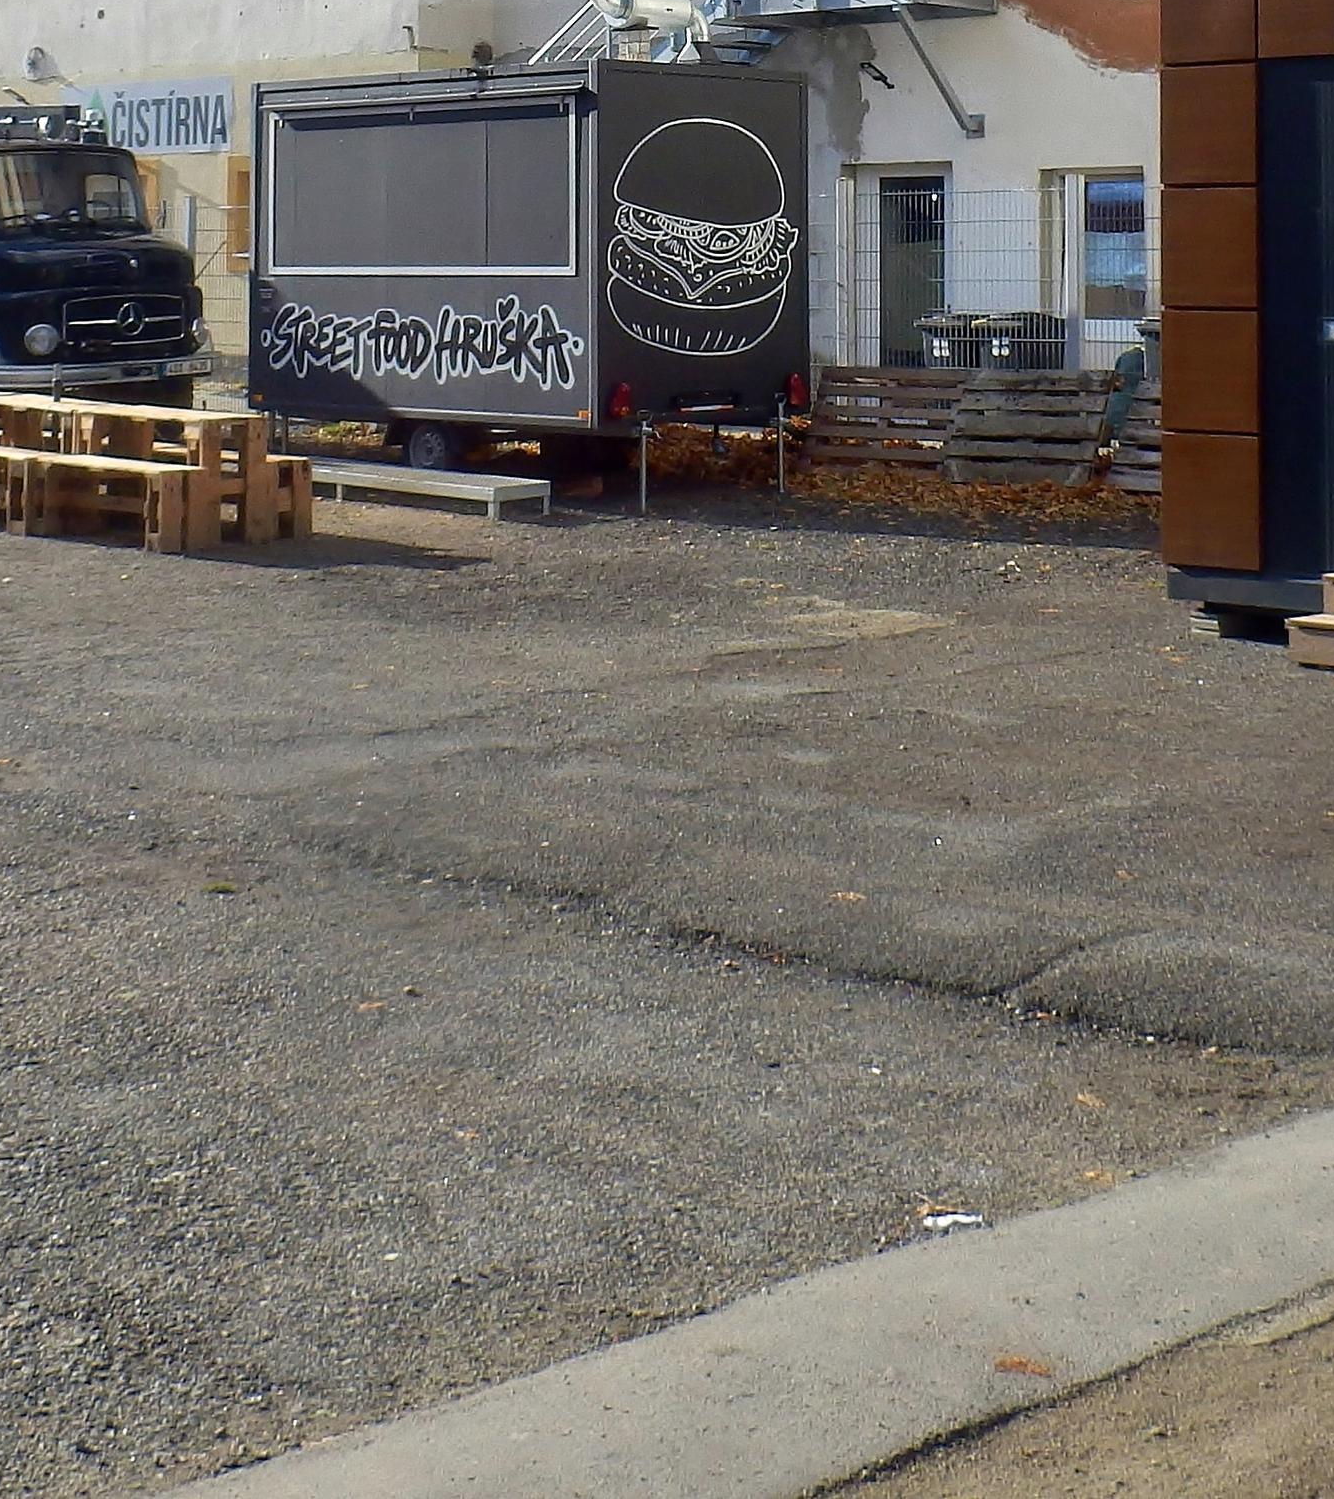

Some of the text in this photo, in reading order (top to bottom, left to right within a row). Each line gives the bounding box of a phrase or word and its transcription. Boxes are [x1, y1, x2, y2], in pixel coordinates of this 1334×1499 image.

[111, 90, 228, 148] ČISTÍRNA
[269, 303, 373, 379] STREET
[367, 309, 435, 380] FOOD
